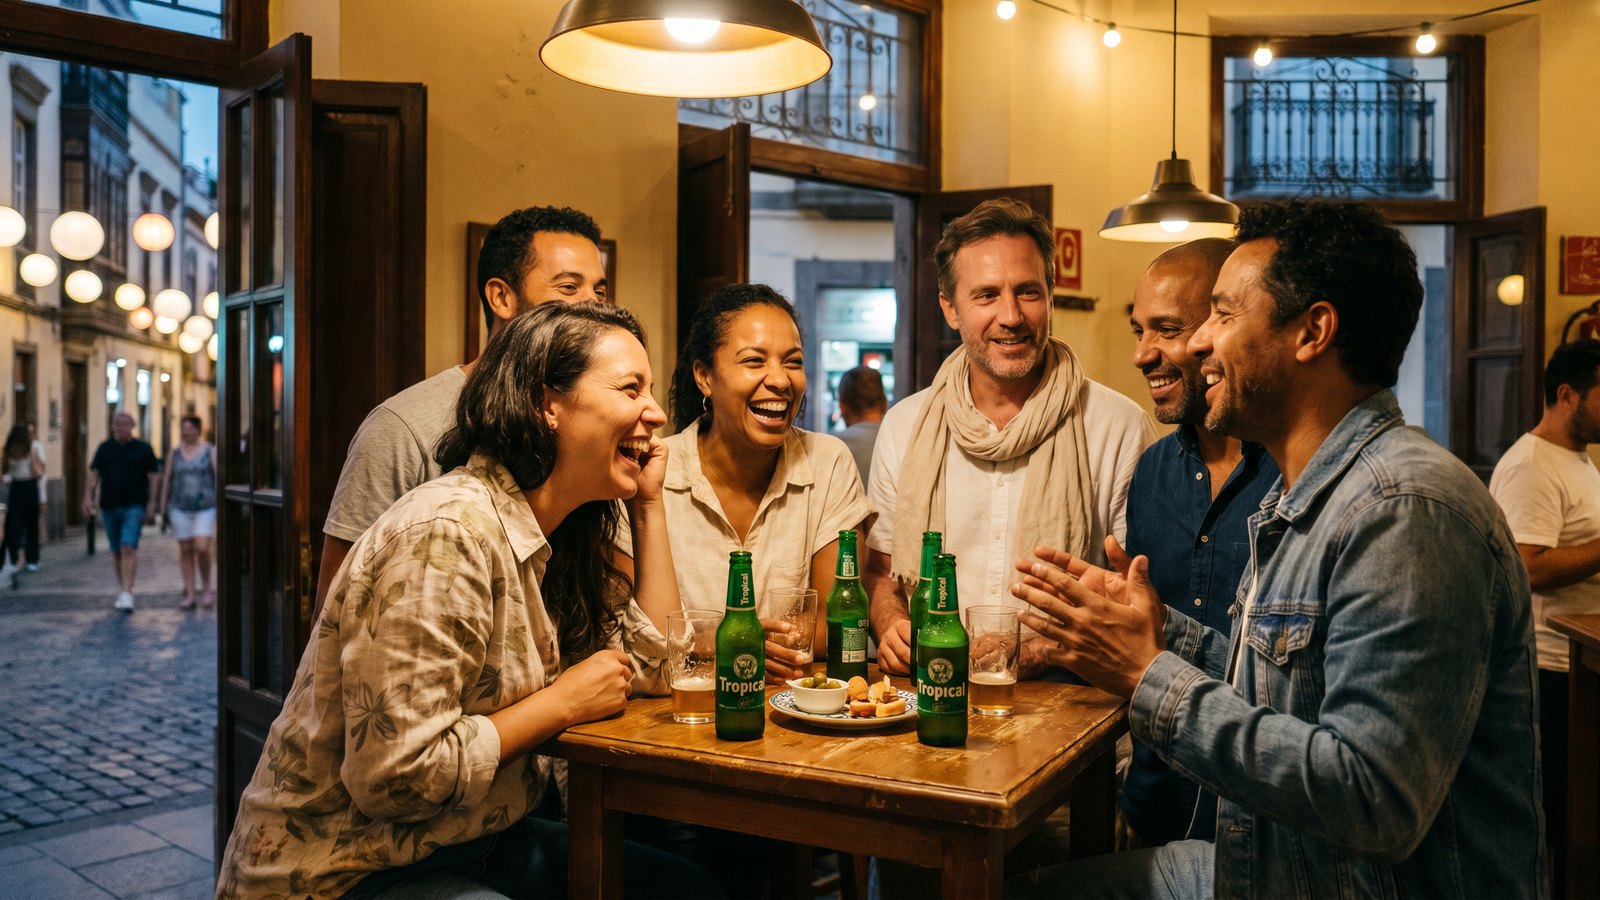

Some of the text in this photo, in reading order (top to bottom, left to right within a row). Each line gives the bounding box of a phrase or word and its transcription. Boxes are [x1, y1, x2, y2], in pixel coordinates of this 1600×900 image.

[740, 573, 749, 605] Tropical
[937, 577, 948, 609] Tropical
[918, 678, 966, 701] Tropical
